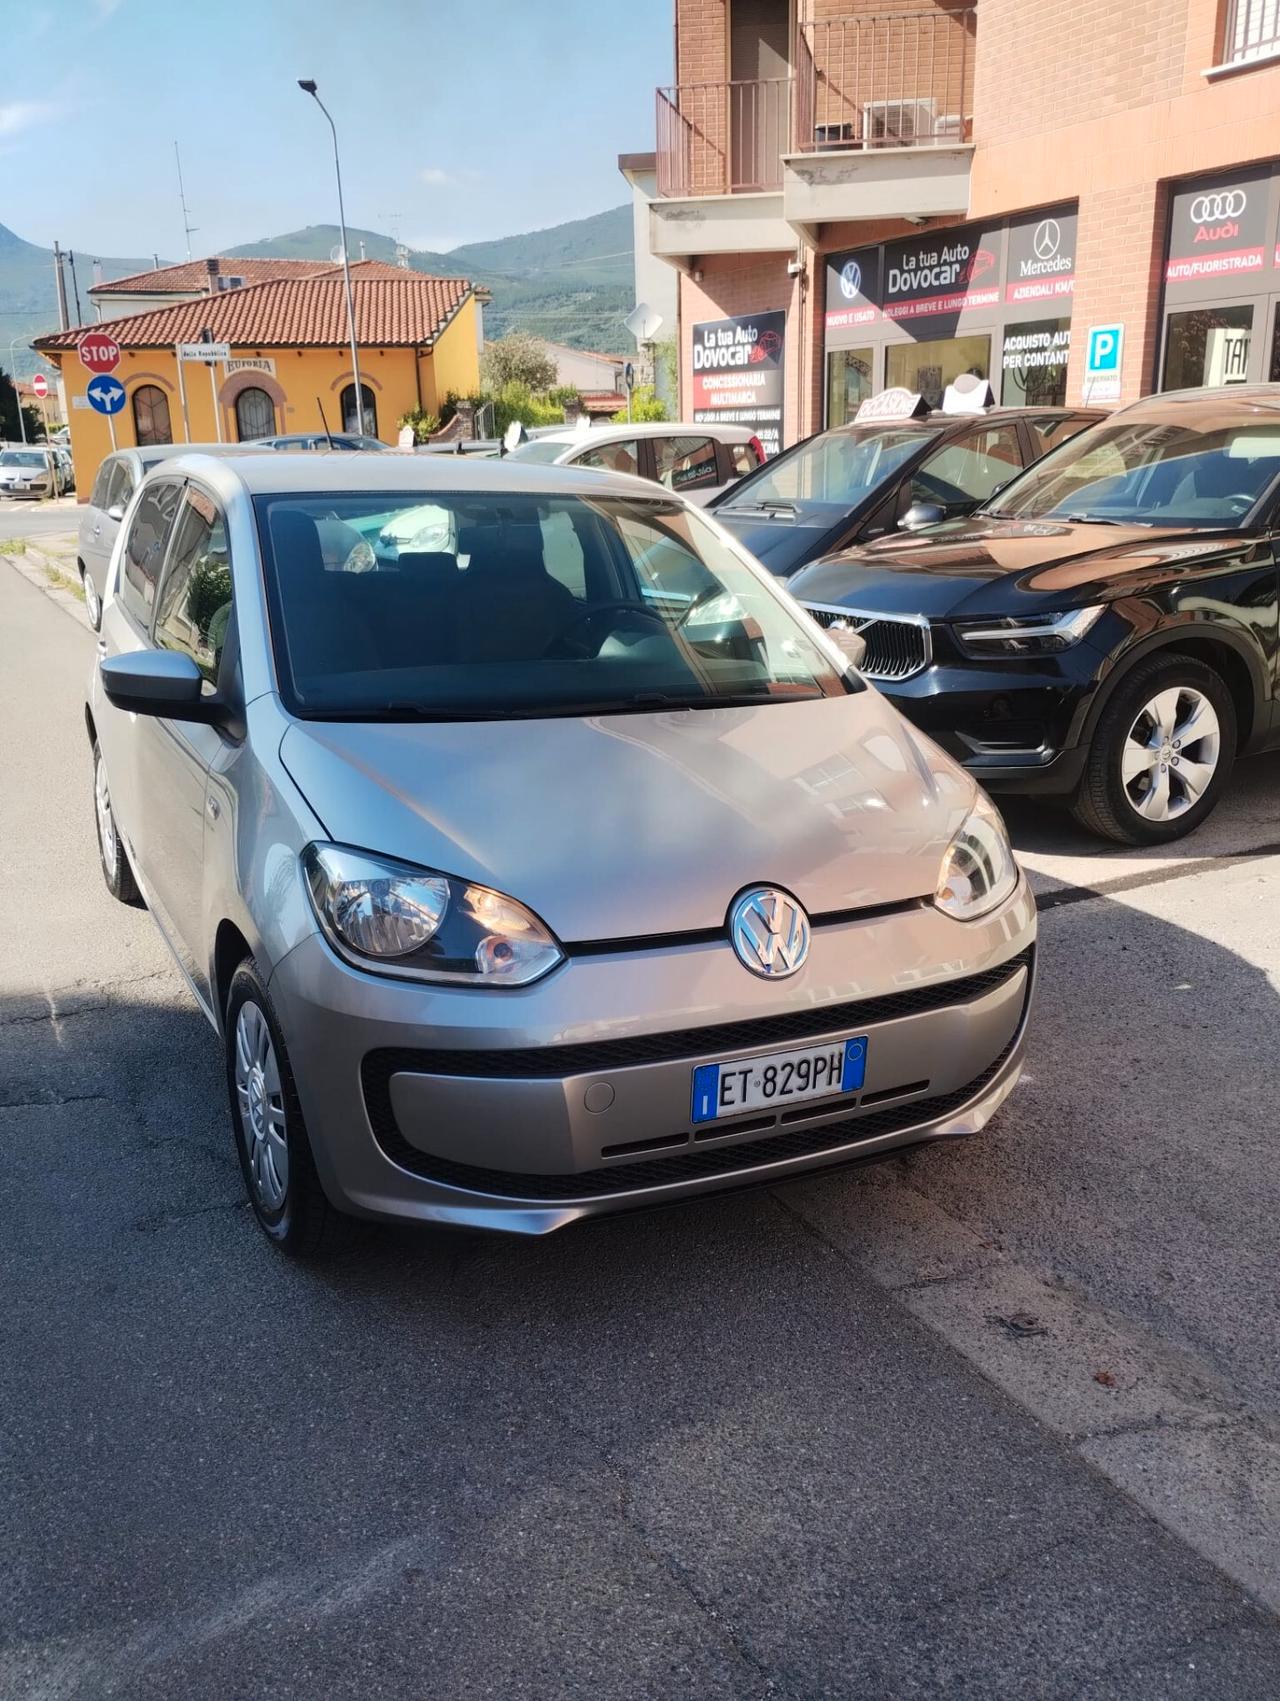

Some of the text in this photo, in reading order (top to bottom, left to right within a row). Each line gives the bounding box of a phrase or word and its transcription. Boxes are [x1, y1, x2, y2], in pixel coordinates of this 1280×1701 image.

[1194, 222, 1240, 243] Audi
[904, 244, 970, 270] La tua Auto
[1020, 255, 1072, 277] Mercedes
[1166, 253, 1263, 278] AUTO/FUORISTRADA
[889, 264, 961, 294] Dovocar
[1014, 284, 1053, 300] AZIENDALI
[855, 311, 875, 323] USATO
[883, 292, 1000, 319] NOLEGGI A BREVE E LUNGO TERMINE
[705, 325, 758, 348] La tua Auto
[1004, 333, 1051, 351] ACQUISTO
[81, 345, 117, 362] STOP
[694, 344, 752, 370] Dovocar
[1004, 355, 1022, 369] PER
[1094, 333, 1115, 368] P
[719, 1051, 844, 1107] ET 829PH
